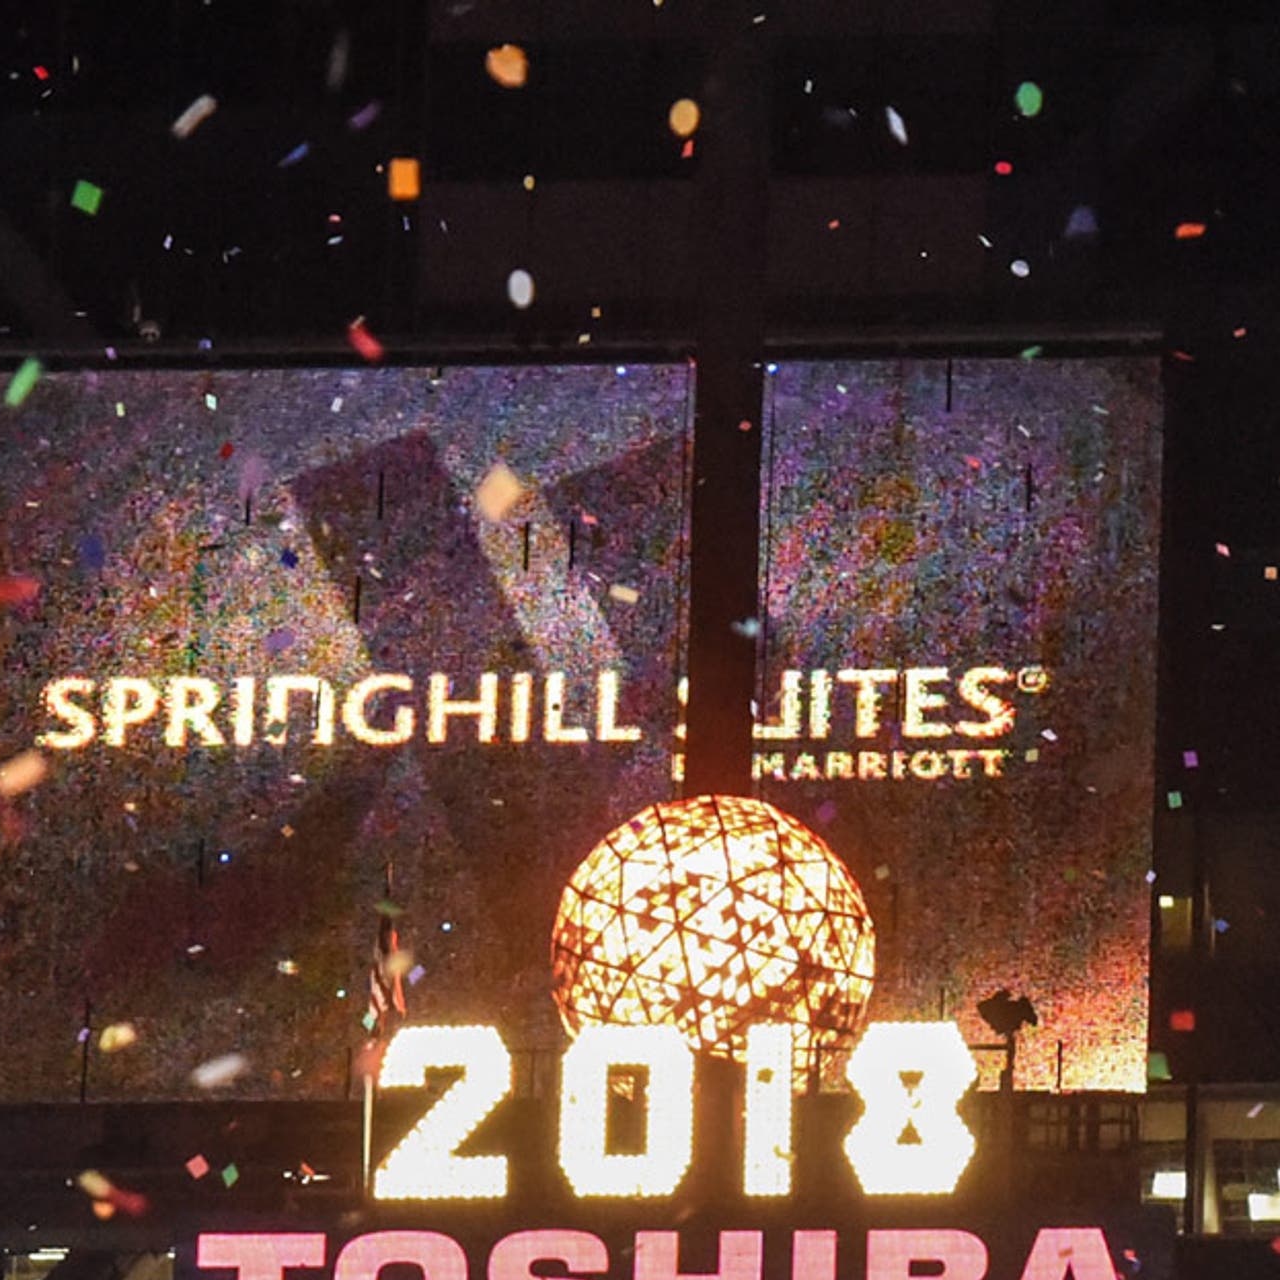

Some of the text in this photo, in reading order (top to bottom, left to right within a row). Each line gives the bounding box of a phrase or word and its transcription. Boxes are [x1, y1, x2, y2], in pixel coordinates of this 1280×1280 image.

[34, 672, 642, 748] SPRINGHILL
[751, 748, 1004, 782] MARRIOTT
[373, 1021, 977, 1200] 2018
